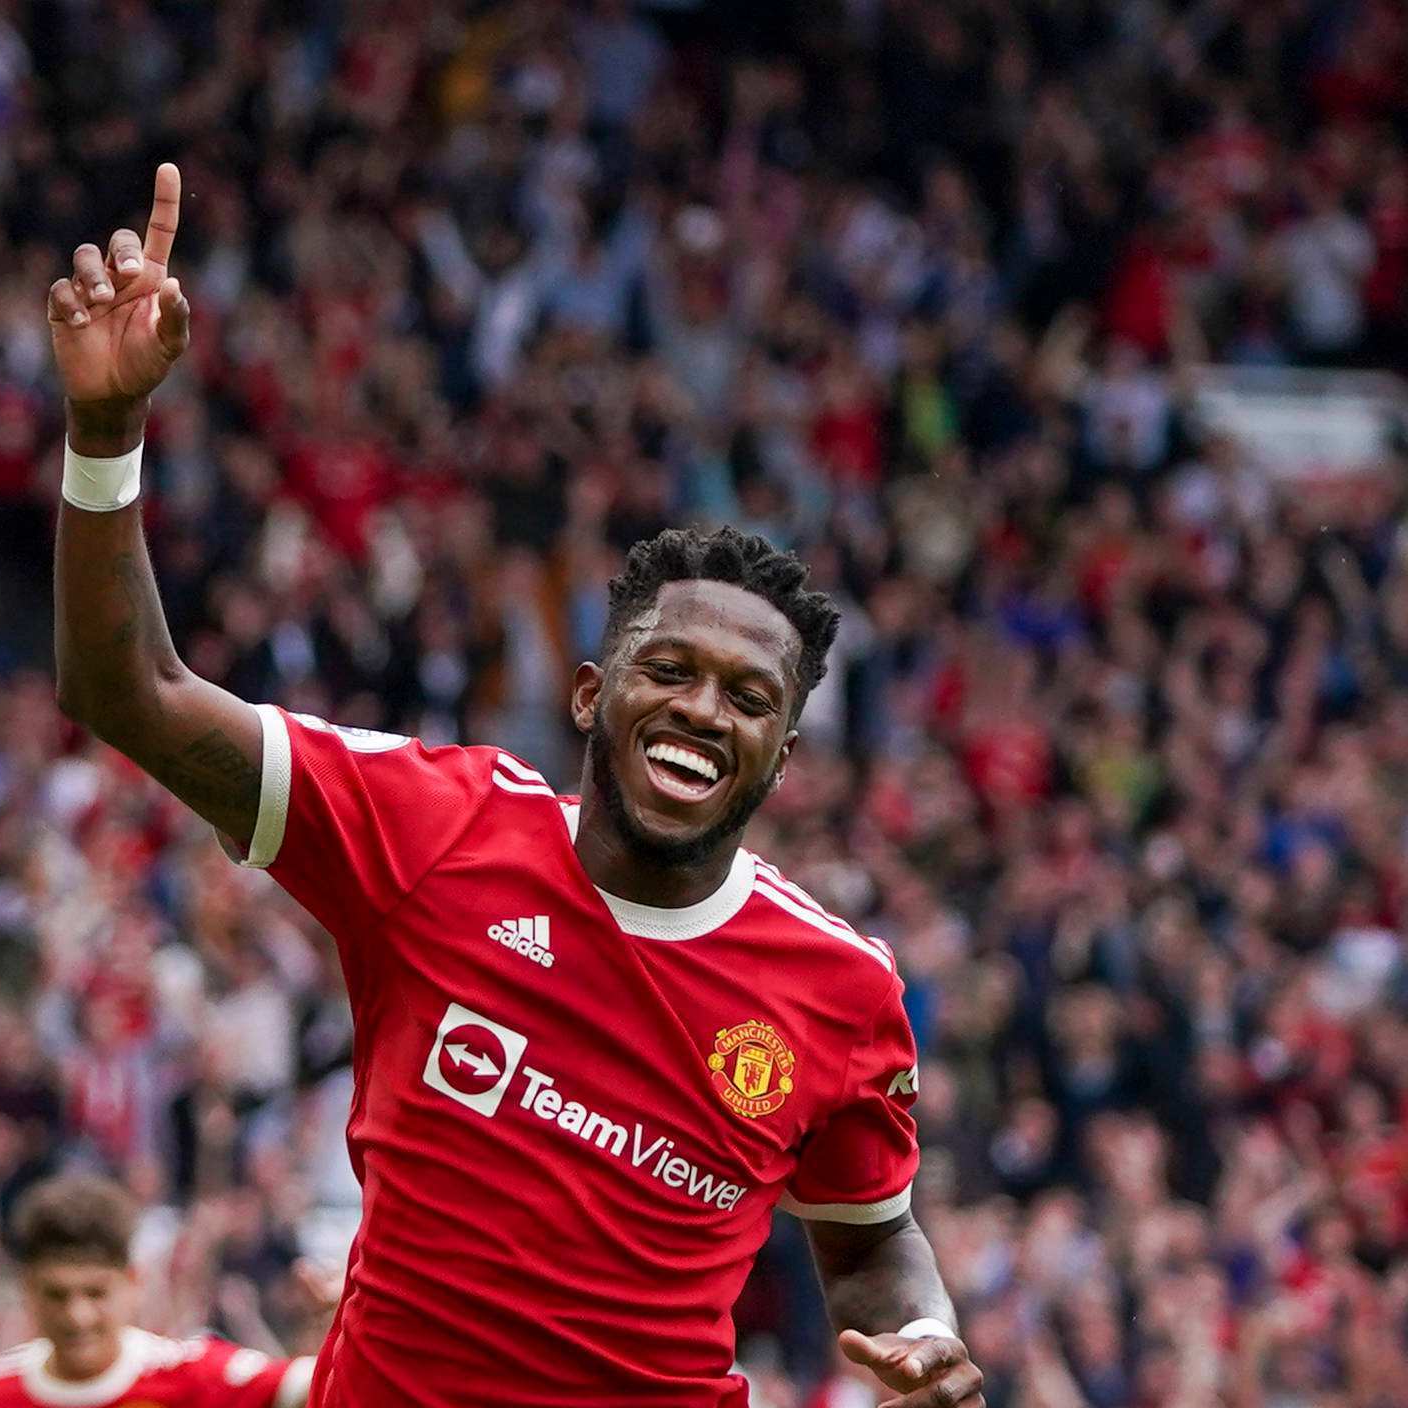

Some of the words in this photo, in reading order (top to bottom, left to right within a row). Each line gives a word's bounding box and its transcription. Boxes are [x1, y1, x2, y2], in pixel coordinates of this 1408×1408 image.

[487, 924, 555, 968] adidas
[721, 1027, 790, 1069] MANCHESTER
[723, 1087, 771, 1111] UNITED
[519, 1066, 748, 1212] TeamViewer
